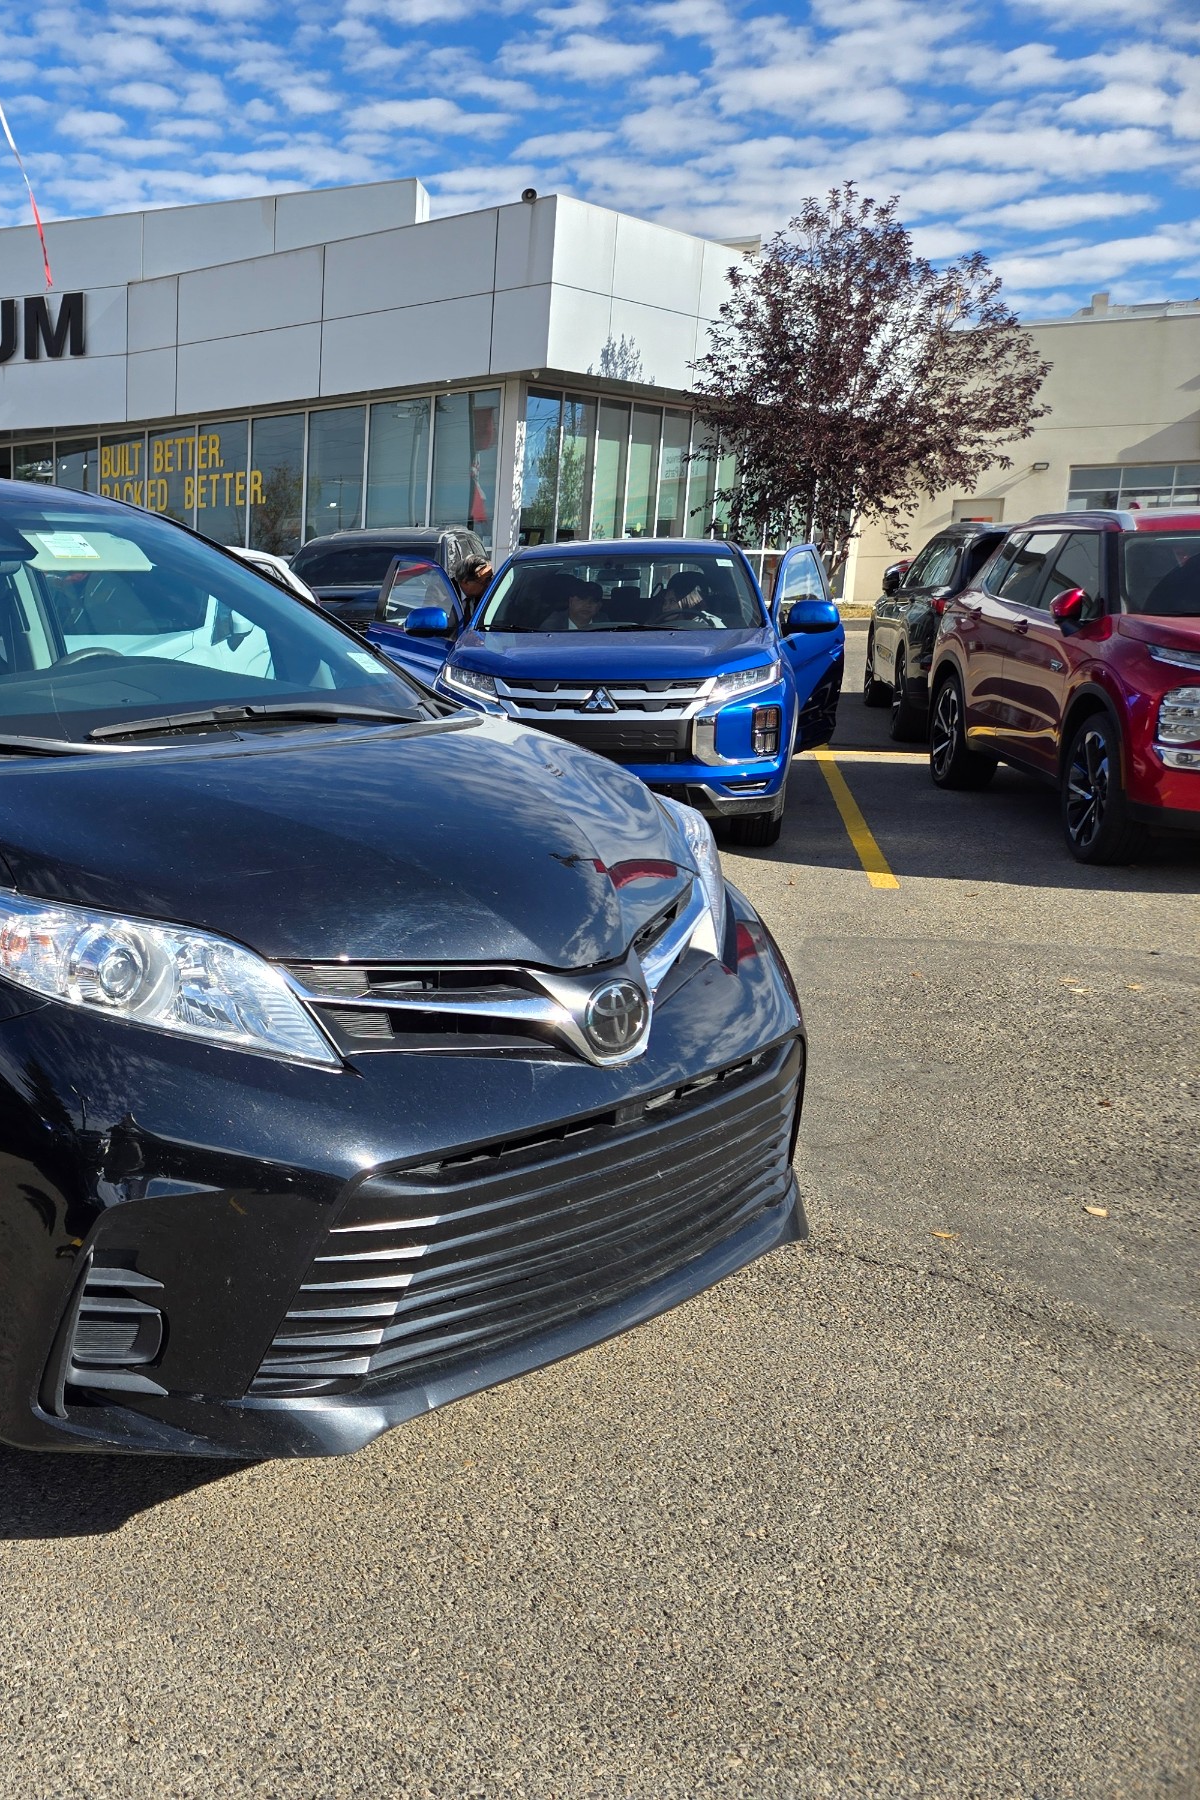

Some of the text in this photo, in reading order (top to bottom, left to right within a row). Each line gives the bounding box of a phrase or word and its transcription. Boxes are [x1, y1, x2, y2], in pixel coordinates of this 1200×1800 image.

[101, 434, 224, 479] BUILT BETTER.
[184, 470, 266, 510] BETTER.
